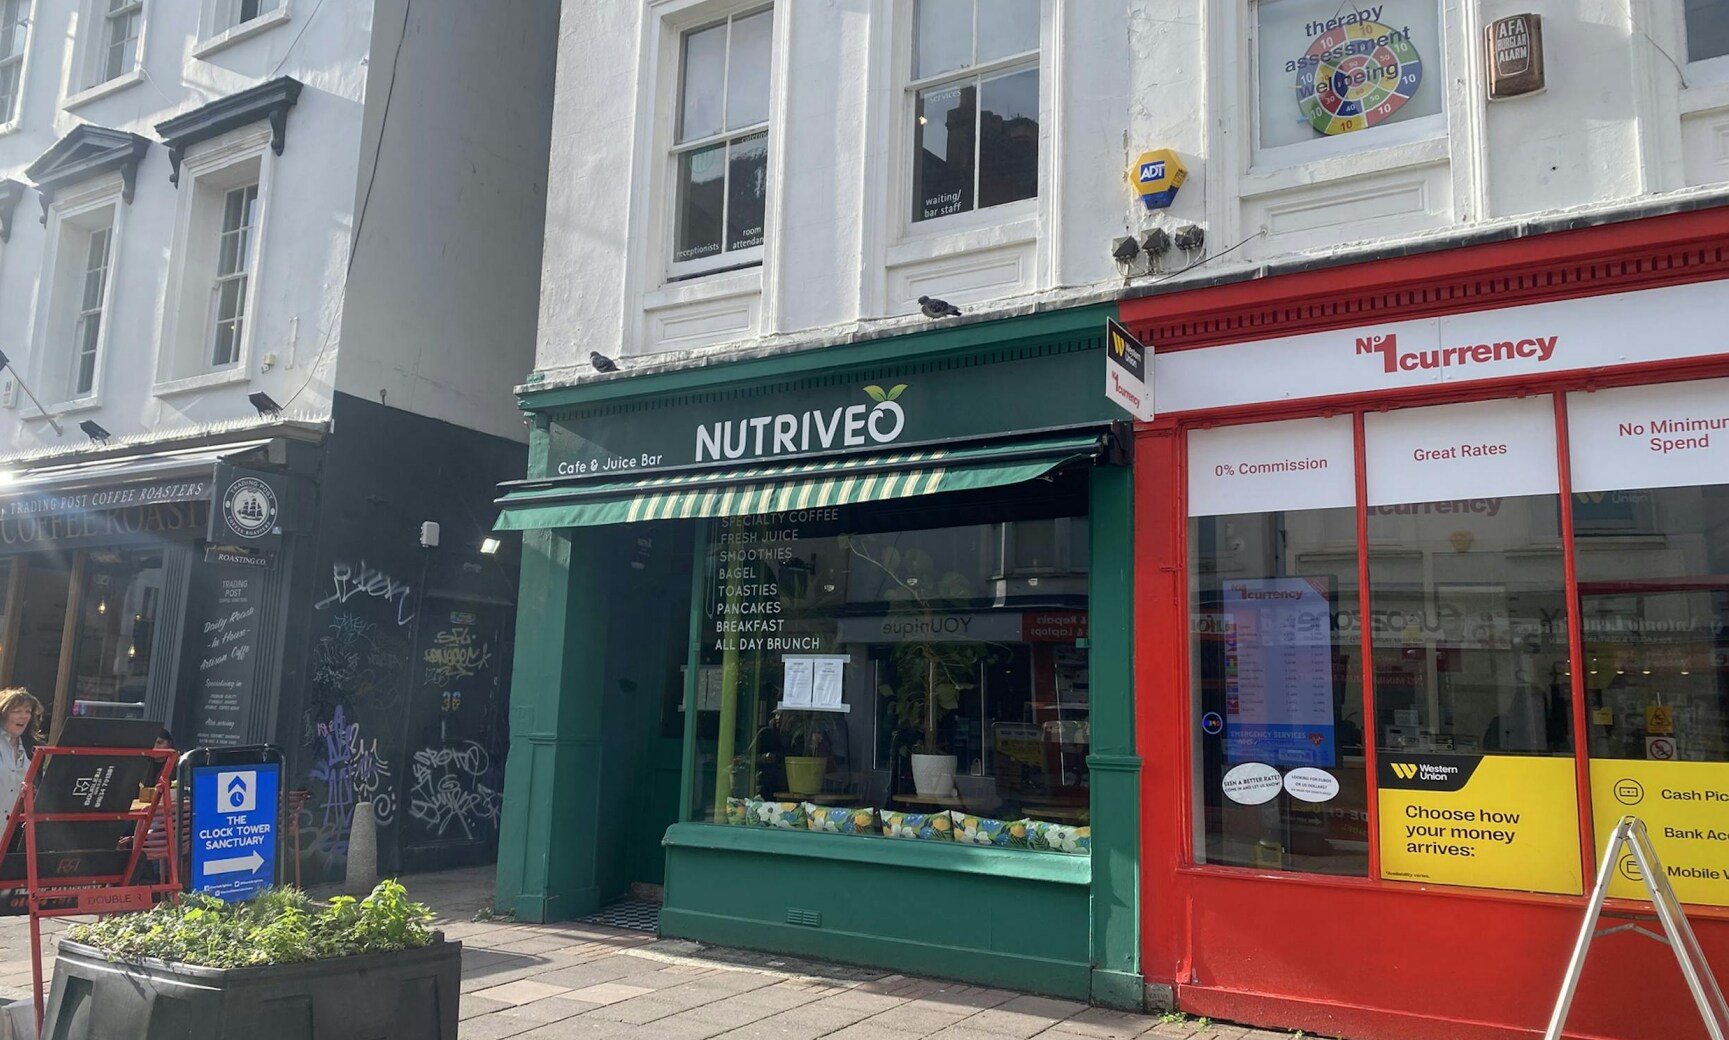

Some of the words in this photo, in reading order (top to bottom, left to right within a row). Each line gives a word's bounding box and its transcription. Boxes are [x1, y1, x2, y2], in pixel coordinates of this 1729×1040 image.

[1305, 5, 1383, 37] therapy
[1499, 18, 1524, 38] AFA
[1285, 25, 1411, 73] assessment
[1320, 37, 1334, 49] 10
[1394, 43, 1408, 53] 10
[1497, 33, 1527, 51] BURGLAR
[1500, 46, 1527, 64] ALARM
[1301, 73, 1313, 85] 10
[1402, 74, 1416, 85] 10
[1311, 107, 1323, 119] 10
[1345, 104, 1356, 112] 40
[1378, 104, 1392, 115] 10
[1341, 120, 1353, 131] 10
[1140, 164, 1166, 180] ADT
[925, 188, 962, 206] waiting/
[924, 208, 938, 218] bar
[940, 201, 962, 215] staff
[743, 226, 761, 237] room
[676, 242, 720, 259] receptionists
[695, 399, 905, 463] NUTRIVEO
[1618, 421, 1645, 437] No
[1413, 445, 1458, 462] Great
[1461, 441, 1508, 458] Rates
[1649, 434, 1709, 454] Spend
[558, 460, 586, 476] Cafe
[590, 459, 599, 471] &
[602, 456, 637, 471] Juice
[641, 453, 663, 466] Bar
[1214, 463, 1235, 478] 0%
[1238, 457, 1328, 475] Commission
[230, 480, 258, 494] TRADING
[259, 483, 274, 500] POST
[10, 497, 57, 515] TRADING
[60, 494, 89, 510] POST
[91, 489, 134, 507] COFFEE
[139, 482, 204, 501] ROASTERS
[105, 502, 209, 537] ROAST
[721, 512, 786, 528] SPECIALTY
[788, 508, 839, 524] COFFEE
[720, 531, 758, 545] FRESH
[761, 528, 799, 543] JUICE
[218, 553, 255, 565] ROASTING
[719, 547, 793, 563] SMOOTHIES
[718, 566, 757, 580] BAGEL
[222, 579, 248, 590] TRADING
[718, 583, 778, 597] TOASTIES
[224, 588, 242, 598] POST
[717, 601, 781, 615] PANCAKES
[716, 619, 785, 633] BREAKFAST
[714, 638, 736, 651] ALL
[739, 638, 764, 651] DAY
[766, 636, 820, 650] BRUNCH
[1419, 763, 1458, 775] Western
[1243, 776, 1263, 784] BETTER
[1263, 774, 1280, 782] RATE?
[1419, 772, 1448, 782] Union
[1661, 789, 1702, 801] Cash
[226, 815, 247, 826] THE
[1405, 805, 1476, 822] Choose
[1480, 809, 1520, 825] how
[199, 827, 233, 840] CLOCK
[236, 823, 271, 836] TOWER
[1406, 825, 1448, 839] your
[1451, 827, 1516, 845] money
[1664, 827, 1704, 840] Bank
[1706, 829, 1729, 841] Ac
[205, 835, 265, 850] SANCTUARY
[1406, 841, 1476, 858] arrives:
[1667, 866, 1720, 880] Mobile
[88, 893, 132, 906] DOUBLE
